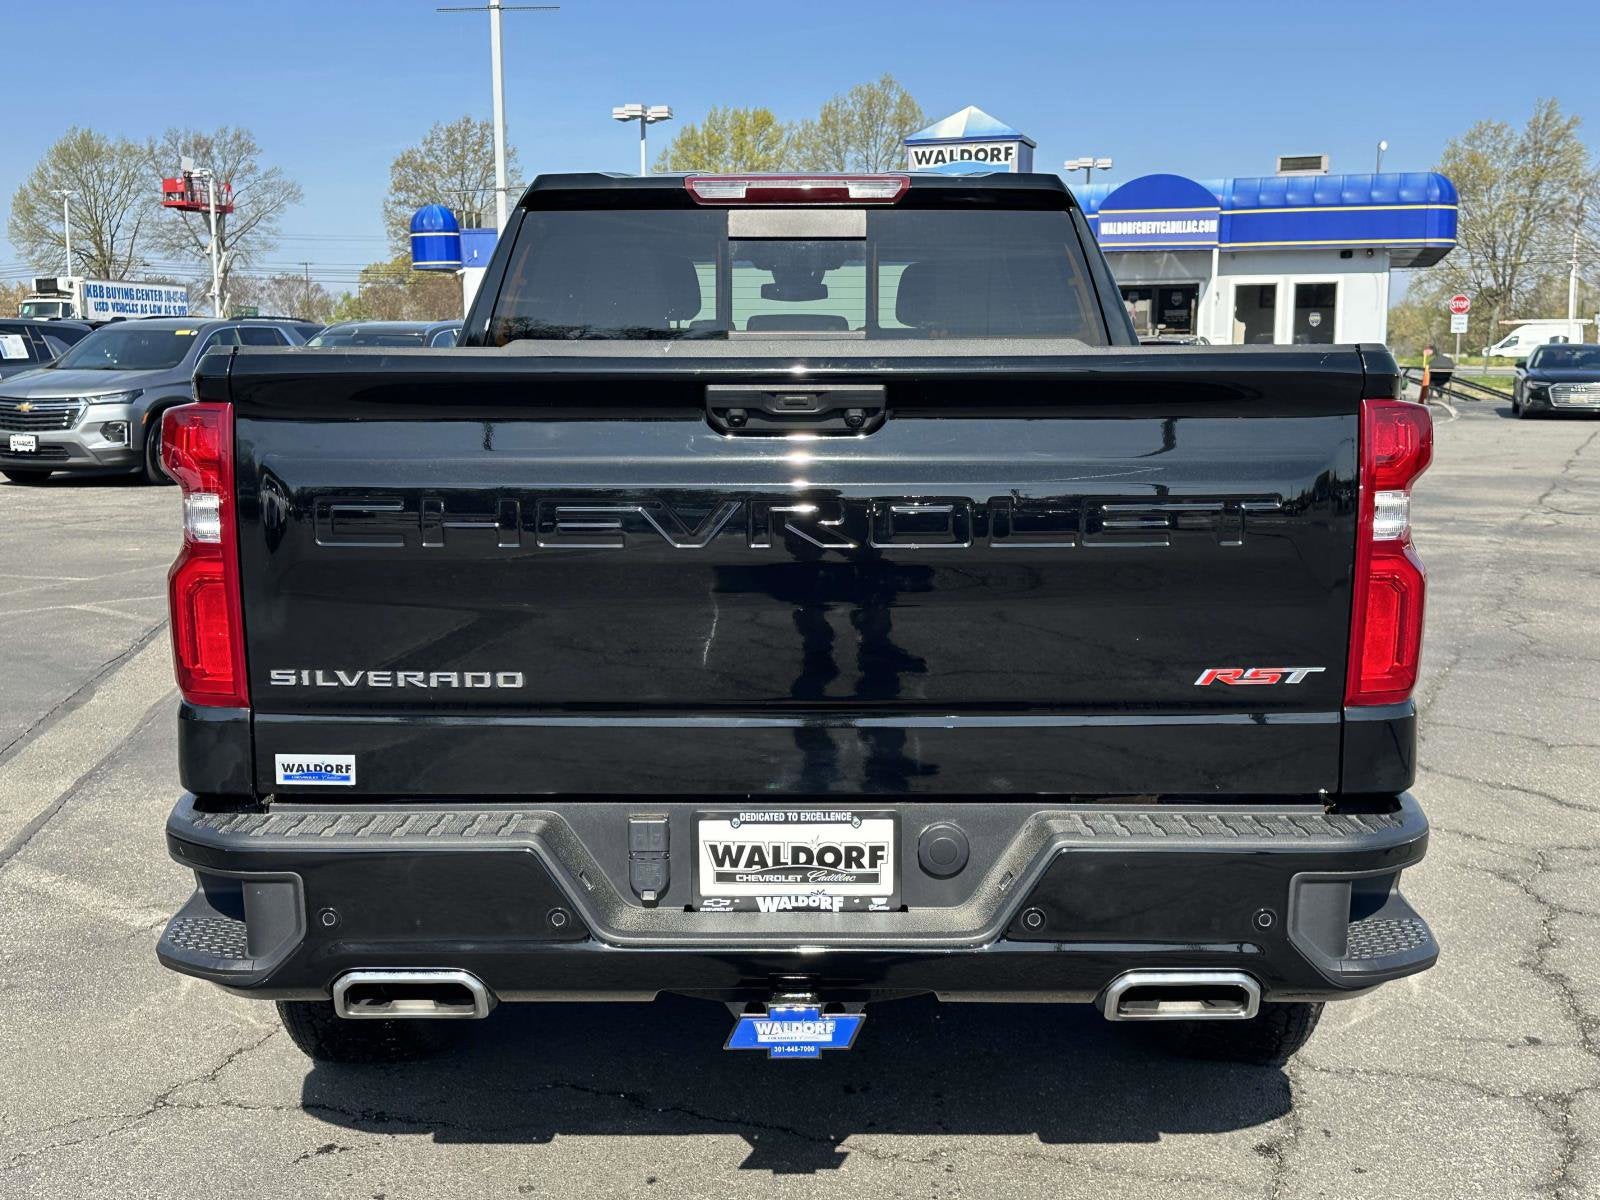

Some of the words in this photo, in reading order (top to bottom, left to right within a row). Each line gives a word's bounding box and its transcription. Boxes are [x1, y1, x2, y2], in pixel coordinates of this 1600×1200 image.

[913, 146, 1014, 166] WALDORF
[1100, 220, 1218, 235] WALDORFCHEVYCADILLAC.COM
[86, 284, 105, 299] KBB
[106, 286, 135, 301] BUYING
[136, 288, 163, 303] CENTER
[95, 302, 110, 312] USED
[111, 303, 138, 315] VEHICLES
[141, 304, 148, 315] AS
[150, 304, 162, 315] LOW
[164, 305, 172, 316] AS
[1451, 301, 1469, 309] STOP
[312, 493, 1283, 549] CHEVROLET
[270, 669, 524, 689] SILVERADO
[1194, 667, 1326, 686] RST
[281, 763, 352, 774] WALDORF
[740, 812, 785, 822] DEDICATED
[787, 812, 798, 821] TO
[800, 812, 851, 821] EXCELLENCE
[708, 844, 886, 869] WALDORF
[735, 874, 802, 882] CHEVROLET
[806, 871, 856, 883] Cadillac
[756, 896, 844, 912] WALDORF
[753, 1021, 836, 1035] WALDORF
